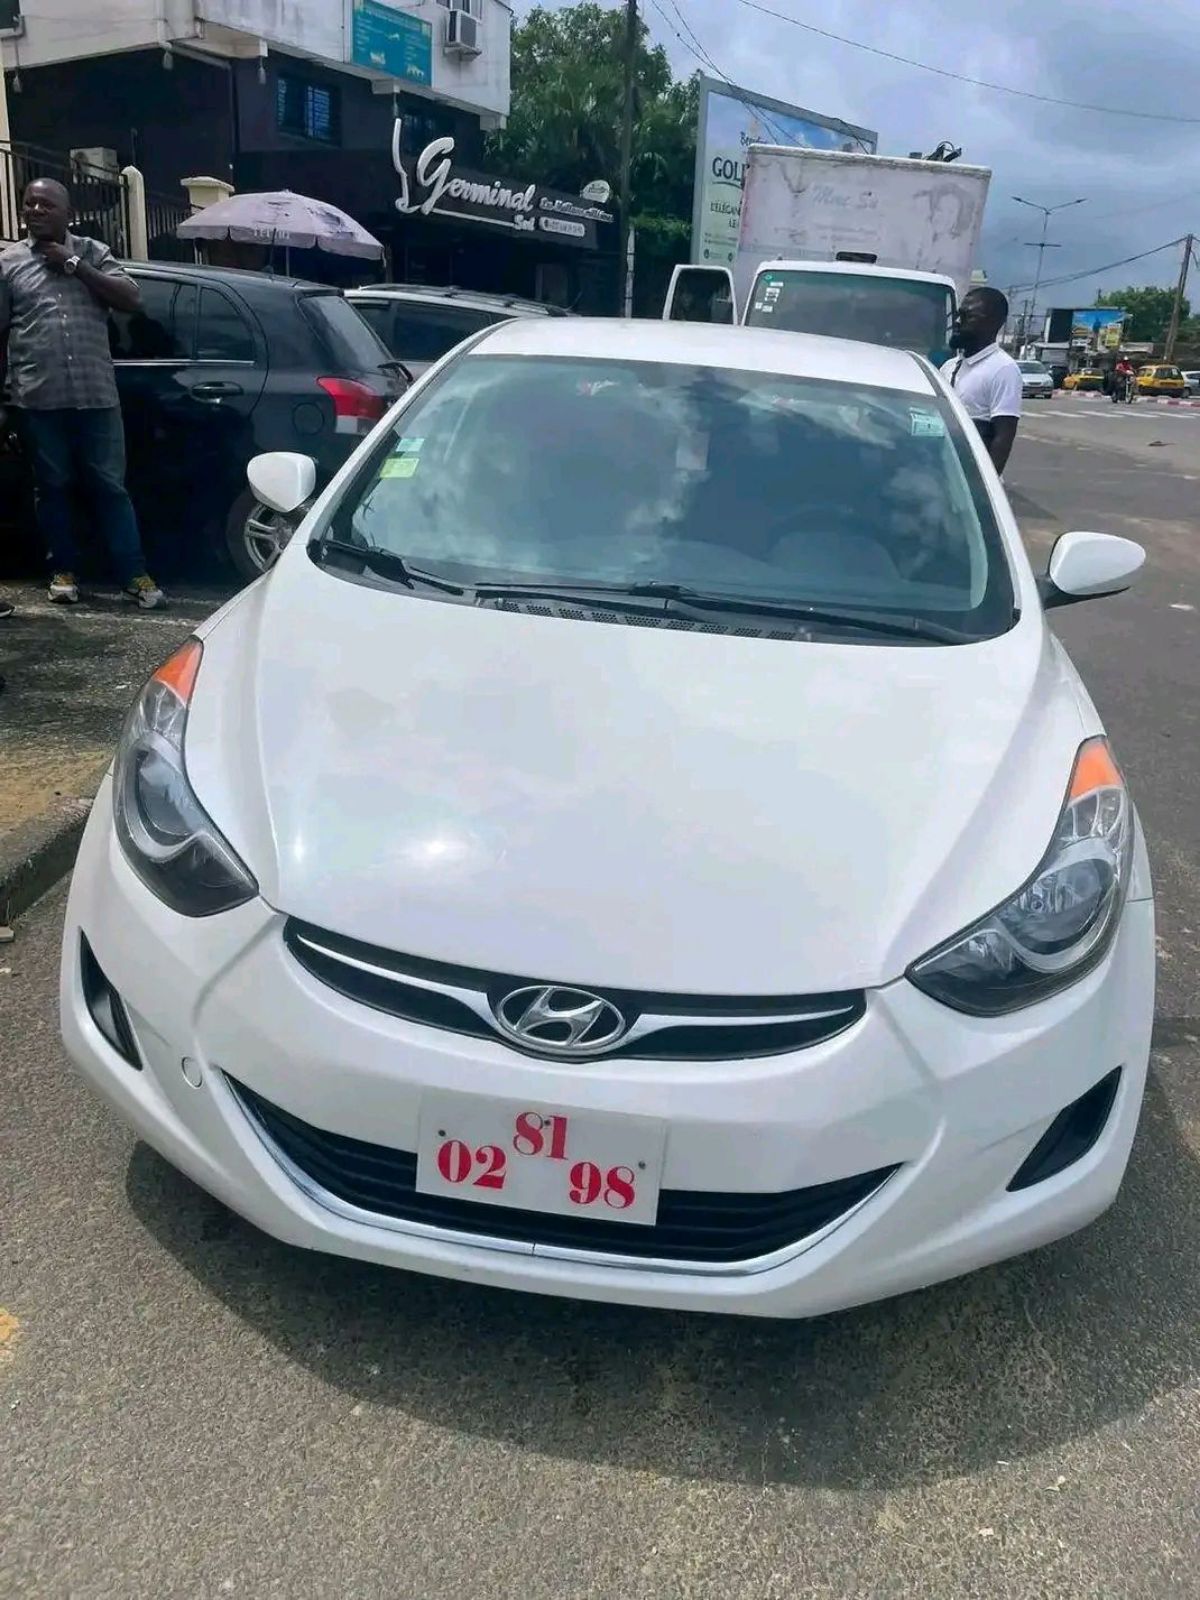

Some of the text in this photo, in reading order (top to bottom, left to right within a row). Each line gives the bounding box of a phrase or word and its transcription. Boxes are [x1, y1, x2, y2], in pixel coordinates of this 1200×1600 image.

[417, 137, 536, 214] Germinal
[513, 1111, 569, 1160] 81
[437, 1139, 636, 1209] 02 98
